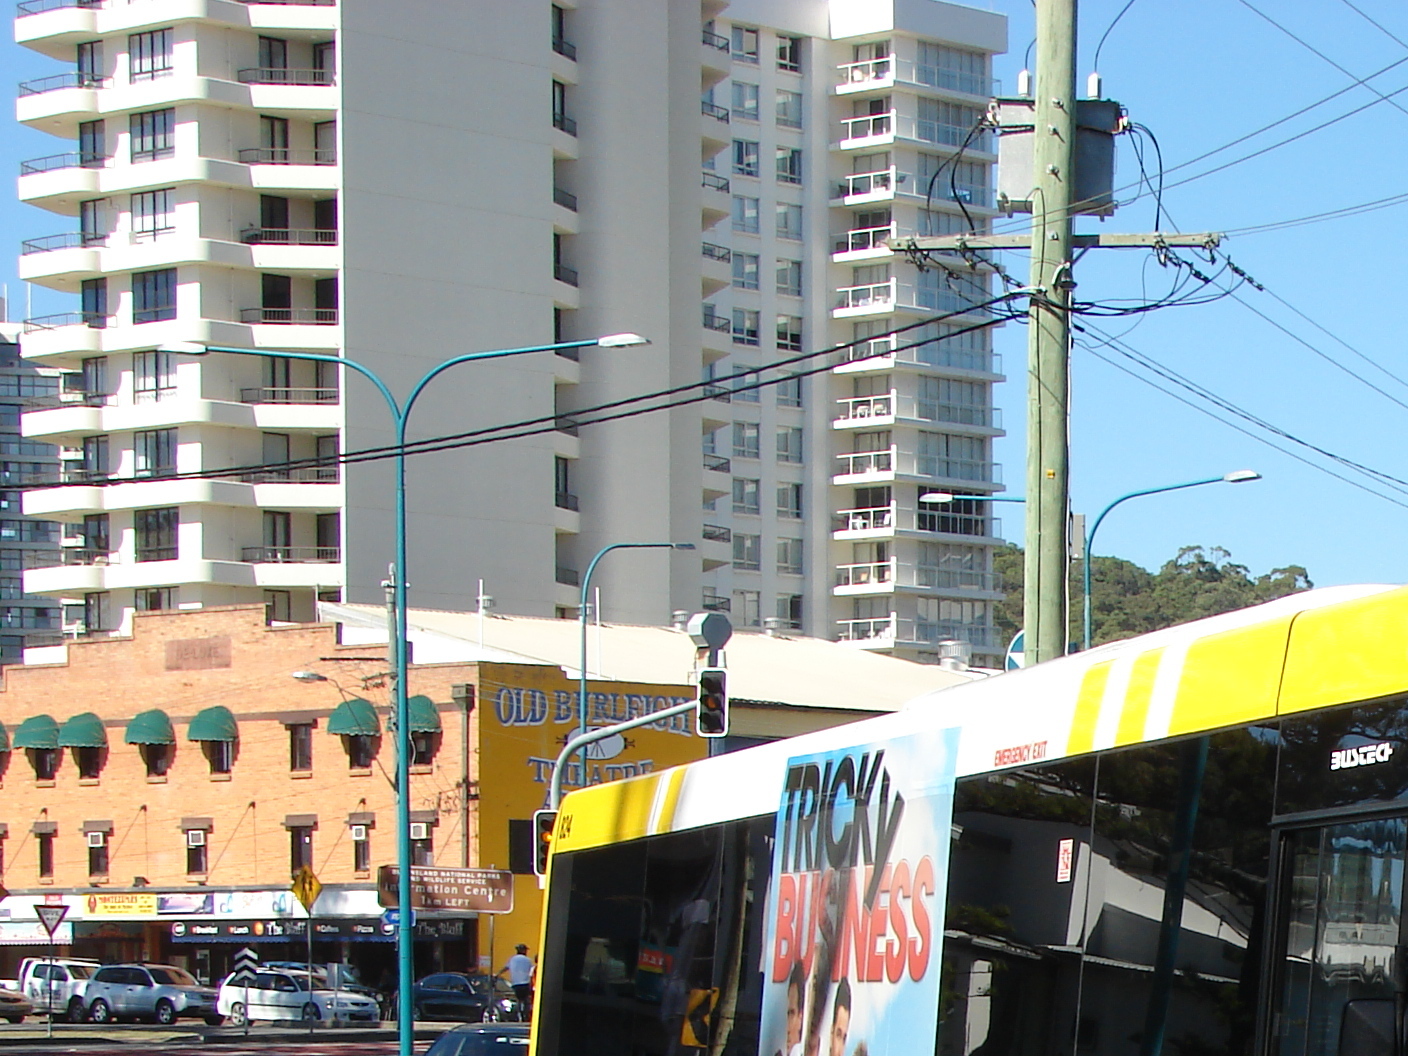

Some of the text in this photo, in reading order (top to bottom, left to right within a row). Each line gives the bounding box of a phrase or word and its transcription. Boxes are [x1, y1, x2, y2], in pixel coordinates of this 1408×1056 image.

[496, 686, 695, 737] OLD BURLEIGH
[1033, 741, 1048, 760] EXIT
[783, 749, 905, 913] TRICKY
[384, 882, 507, 896] Inrmation Centre
[445, 898, 470, 906] LEFT
[266, 921, 284, 936] The
[772, 854, 935, 984] BUSINESS
